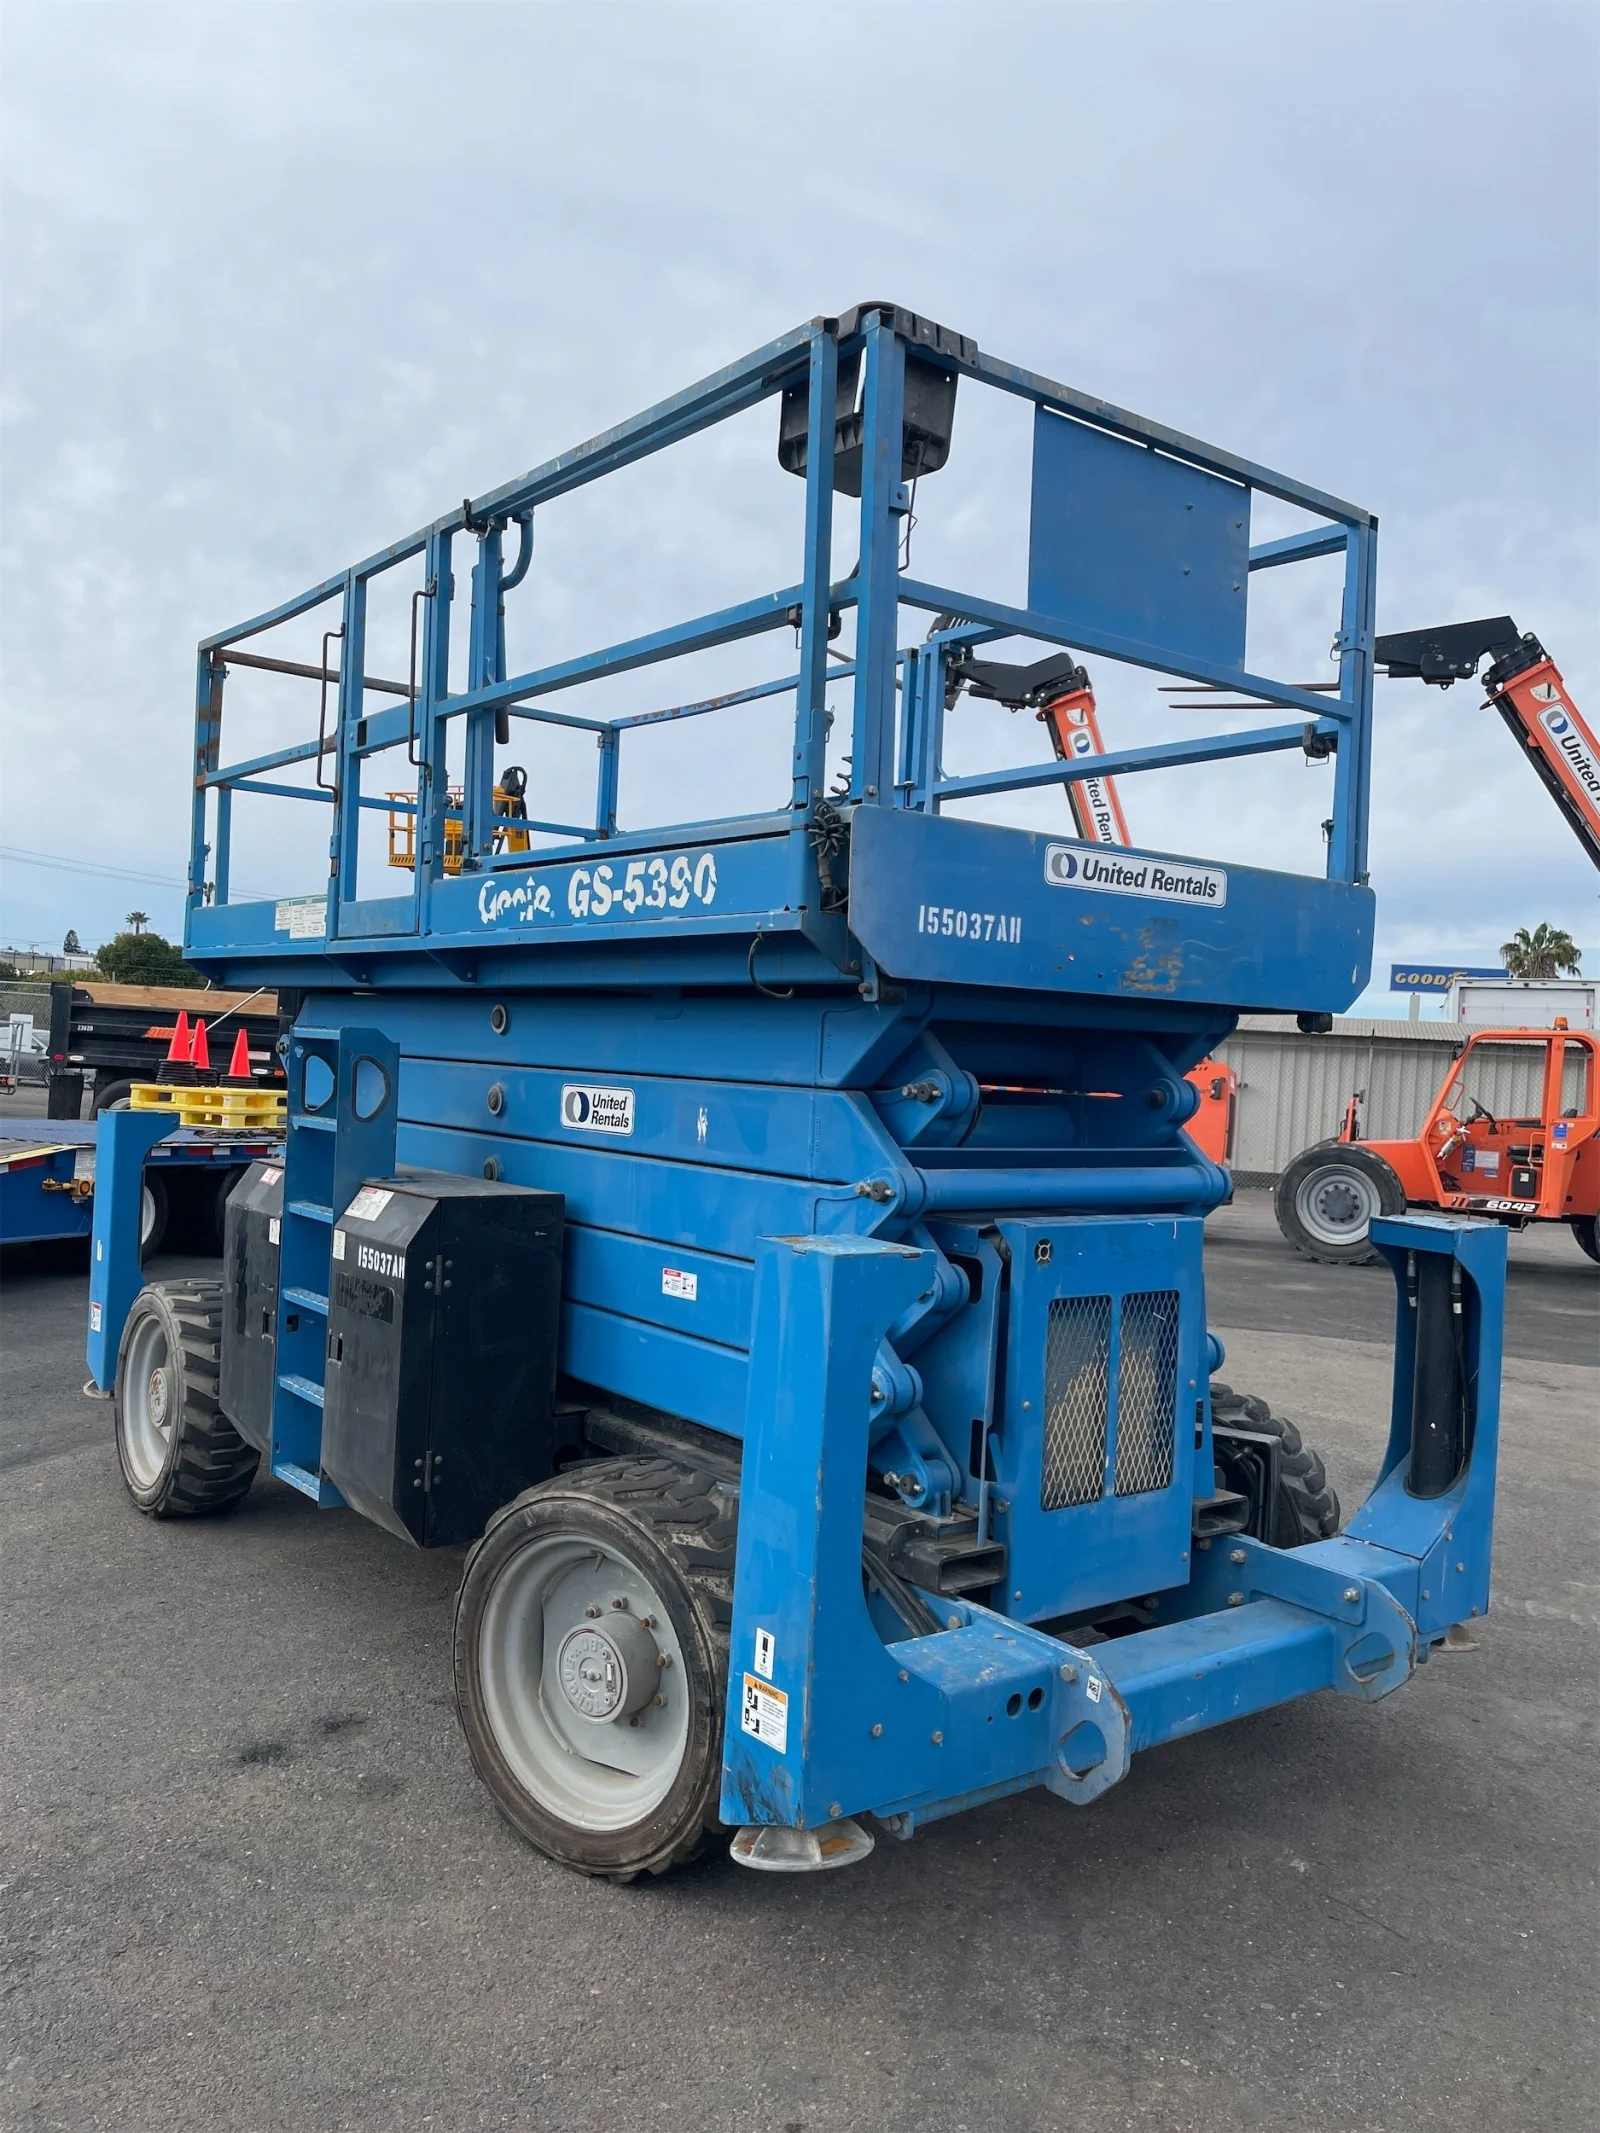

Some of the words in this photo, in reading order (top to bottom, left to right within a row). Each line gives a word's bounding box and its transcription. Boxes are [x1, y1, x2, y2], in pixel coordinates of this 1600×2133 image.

[1086, 776, 1107, 812] ited
[567, 852, 718, 918] GS-5390
[1082, 857, 1148, 889] United
[1150, 868, 1218, 898] Rentals
[591, 1093, 628, 1111] United
[590, 1110, 630, 1129] Rentals
[1485, 1200, 1536, 1213] 6042
